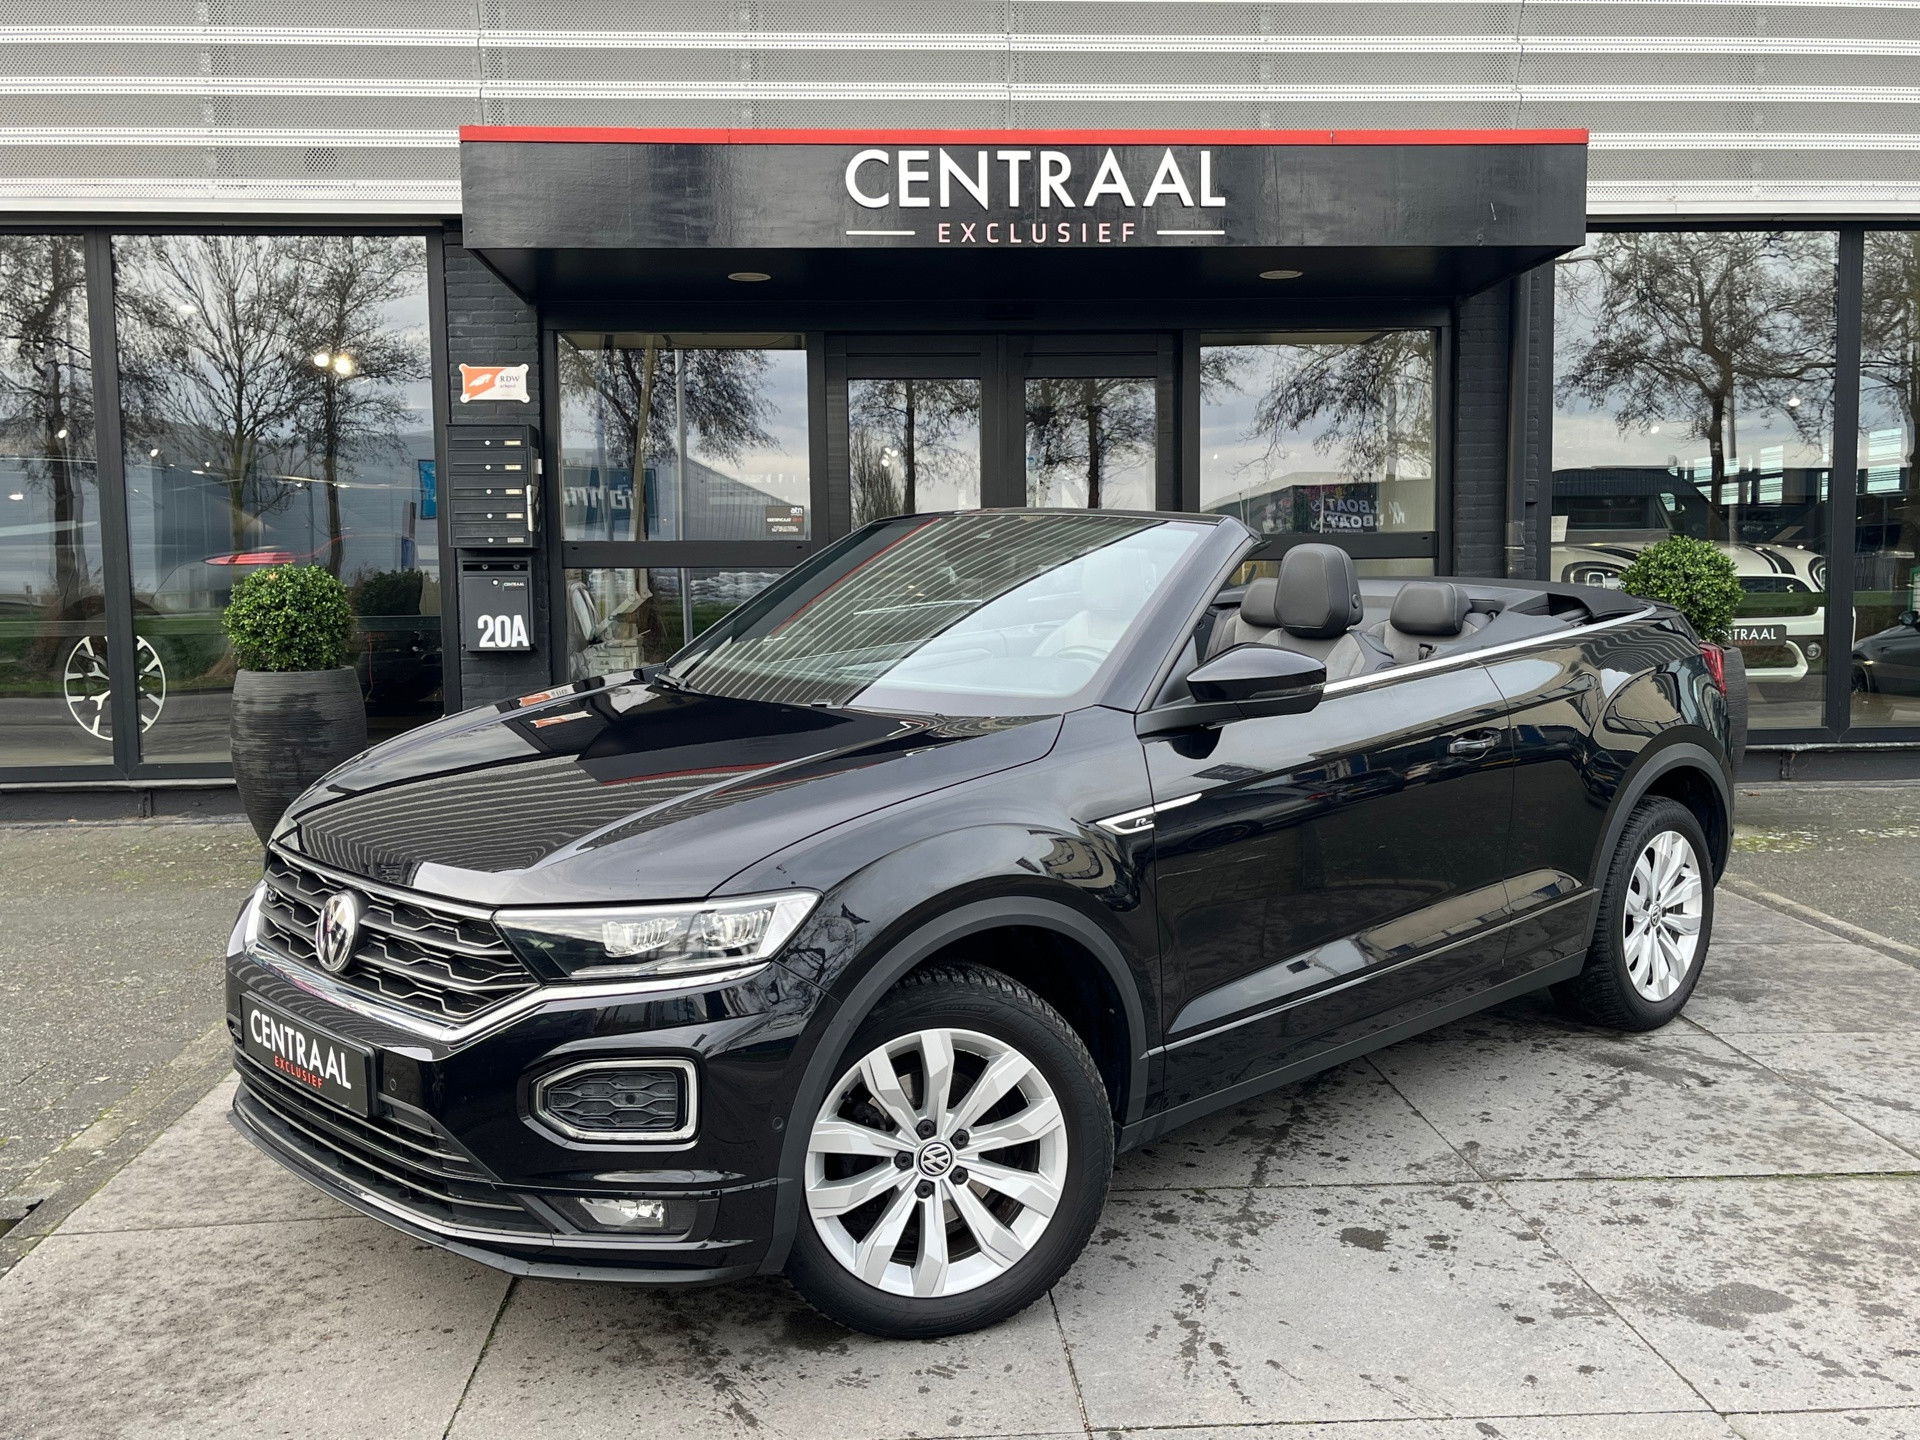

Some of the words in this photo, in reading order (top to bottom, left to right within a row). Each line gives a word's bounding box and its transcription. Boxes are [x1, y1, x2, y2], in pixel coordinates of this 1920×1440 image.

[845, 147, 1226, 210] CENTRAAL
[937, 222, 1136, 243] EXCLUSIEF
[500, 375, 520, 383] RDW
[477, 614, 530, 647] 20A
[250, 1009, 352, 1090] CENTRAAL
[274, 1055, 324, 1089] EXCLUSIEF
